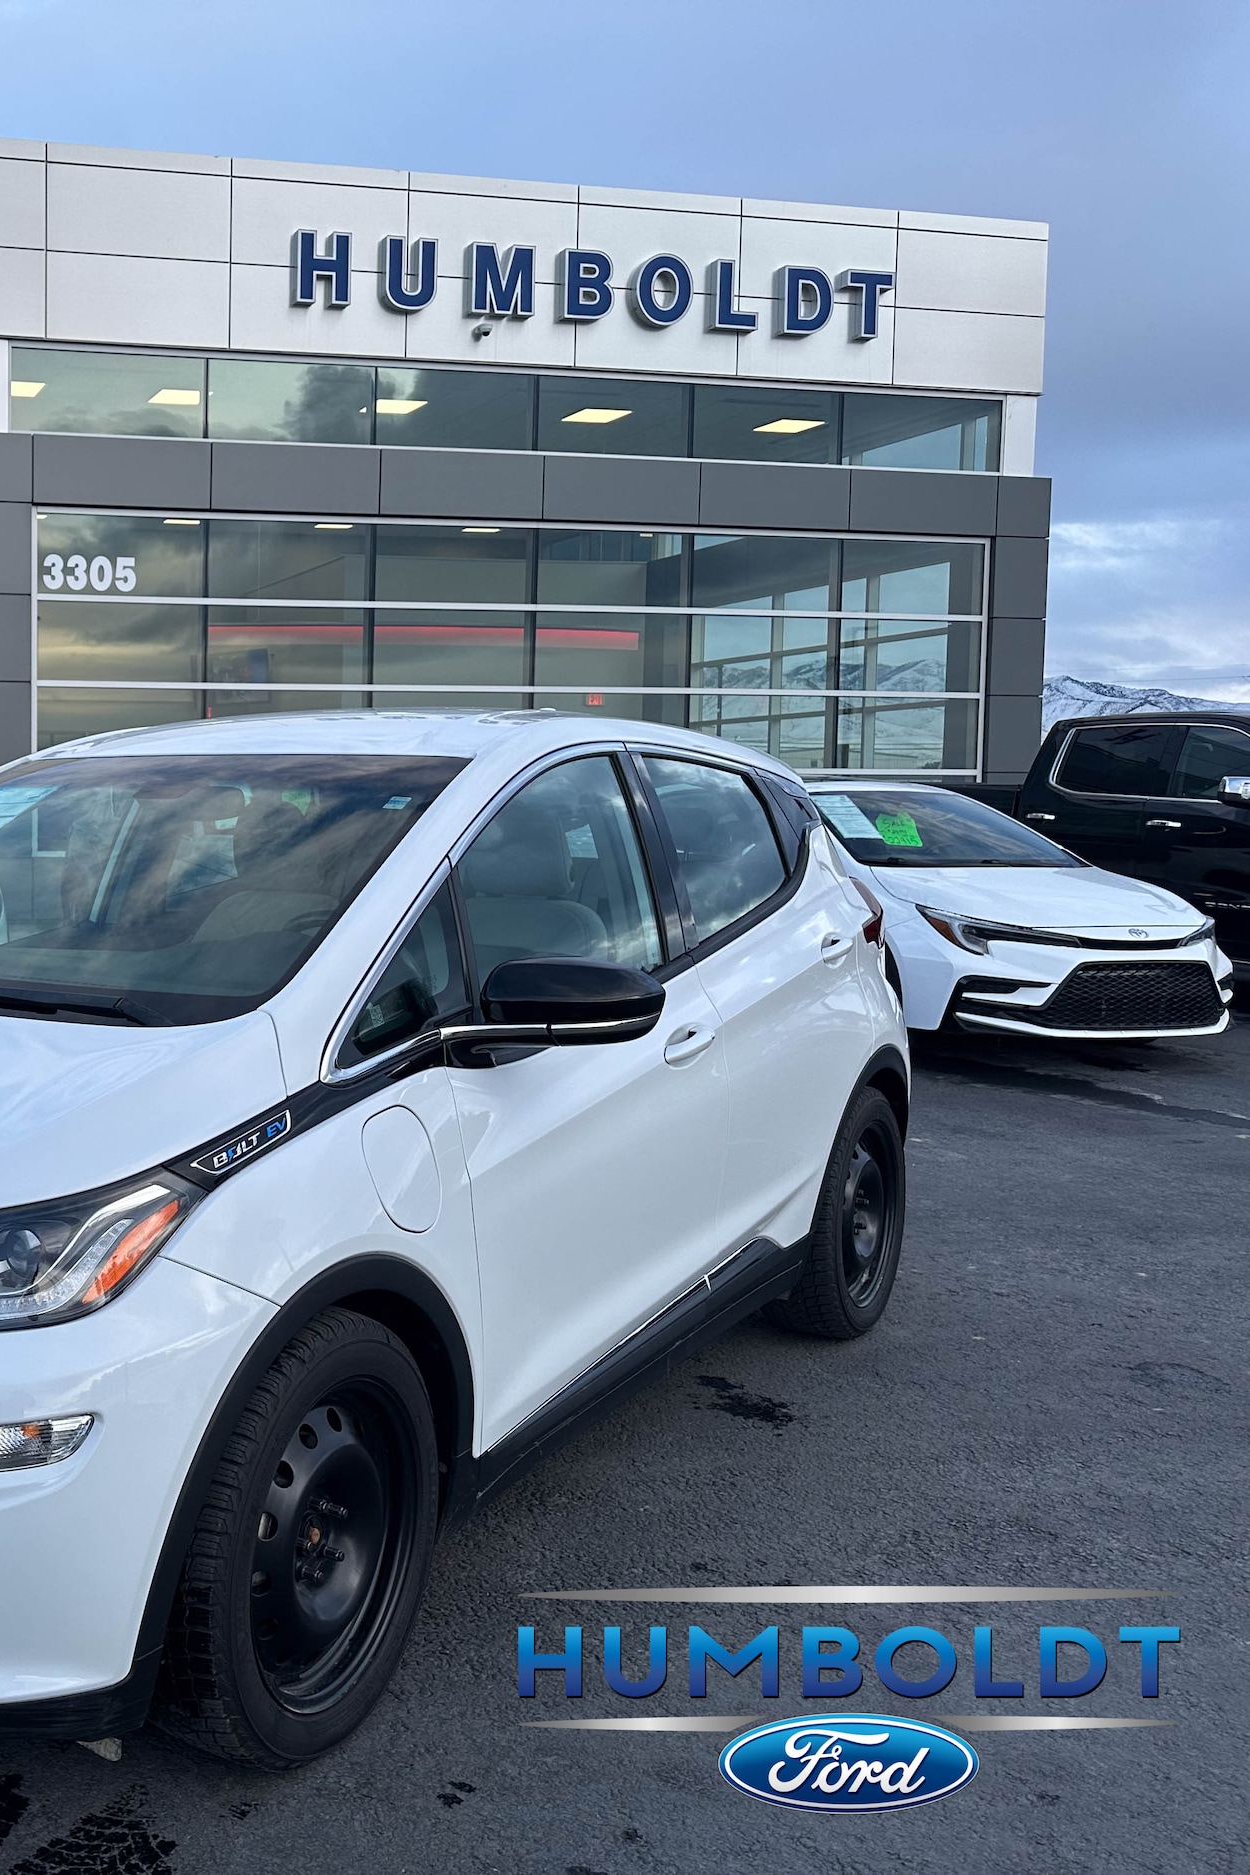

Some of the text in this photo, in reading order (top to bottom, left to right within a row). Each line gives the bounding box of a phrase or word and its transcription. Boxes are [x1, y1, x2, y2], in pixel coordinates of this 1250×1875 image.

[291, 228, 897, 342] HUMBOLDT
[42, 553, 137, 592] 3305
[213, 1117, 286, 1169] BOLT EV
